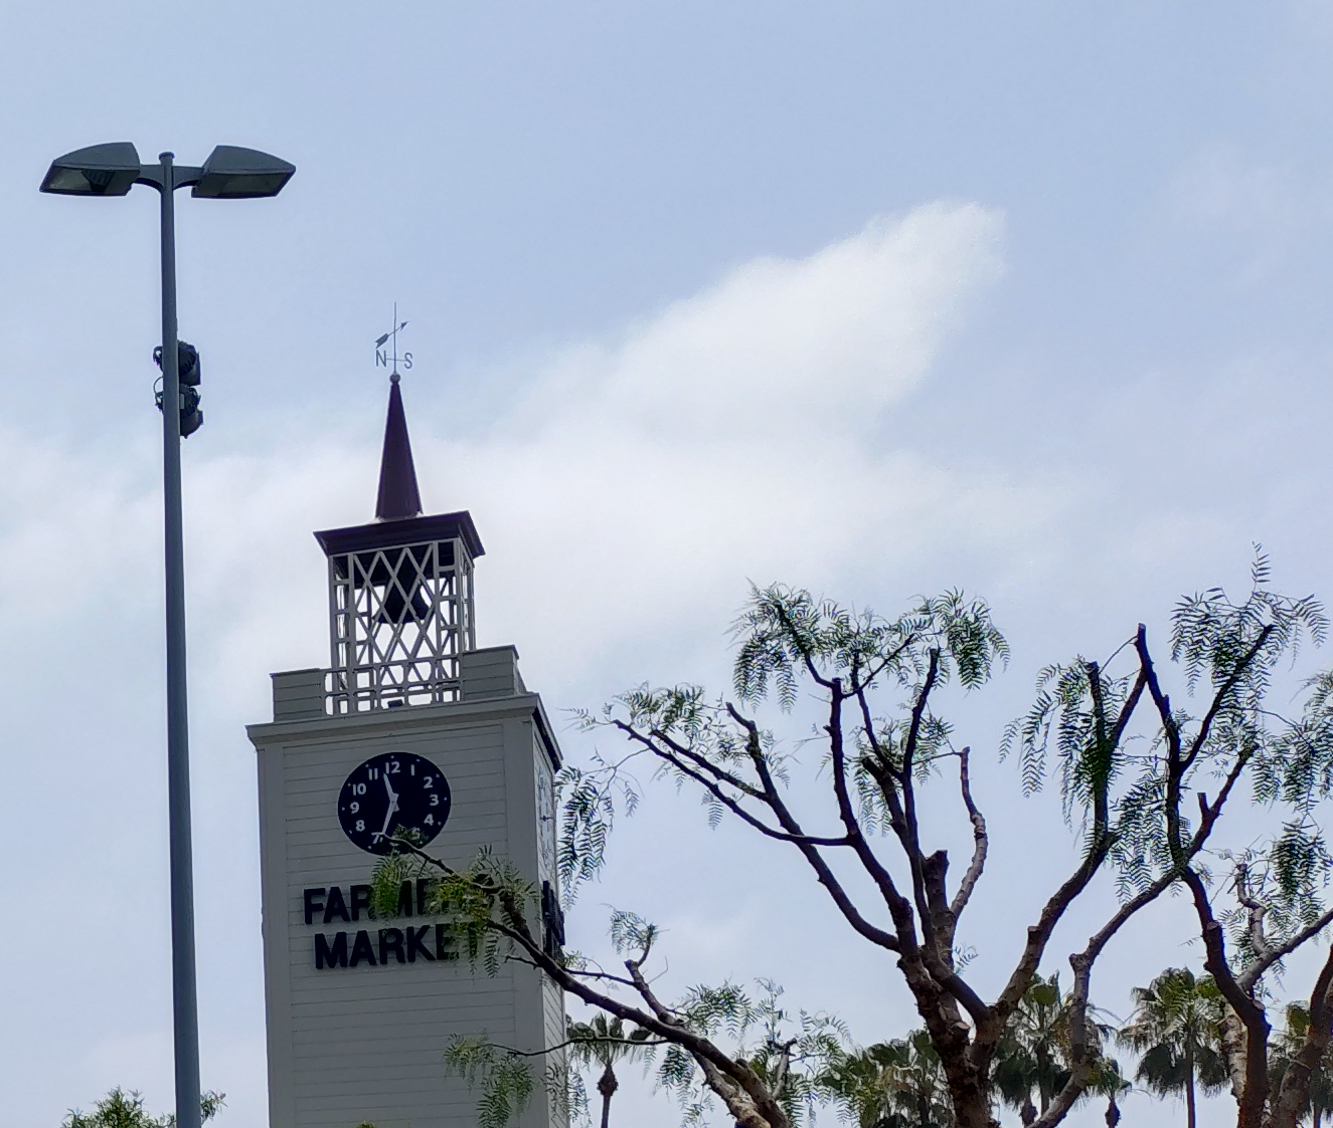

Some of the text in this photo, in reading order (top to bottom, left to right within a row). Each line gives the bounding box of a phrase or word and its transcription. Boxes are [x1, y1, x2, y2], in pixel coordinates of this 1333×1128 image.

[376, 350, 413, 369] N S
[385, 761, 401, 774] 12
[410, 764, 415, 776] 1
[368, 768, 378, 781] 11
[423, 776, 433, 789] 2
[353, 783, 367, 796] 10
[429, 794, 439, 807] 3
[350, 801, 360, 814] 9
[355, 819, 365, 832] 8
[423, 813, 434, 826] 4
